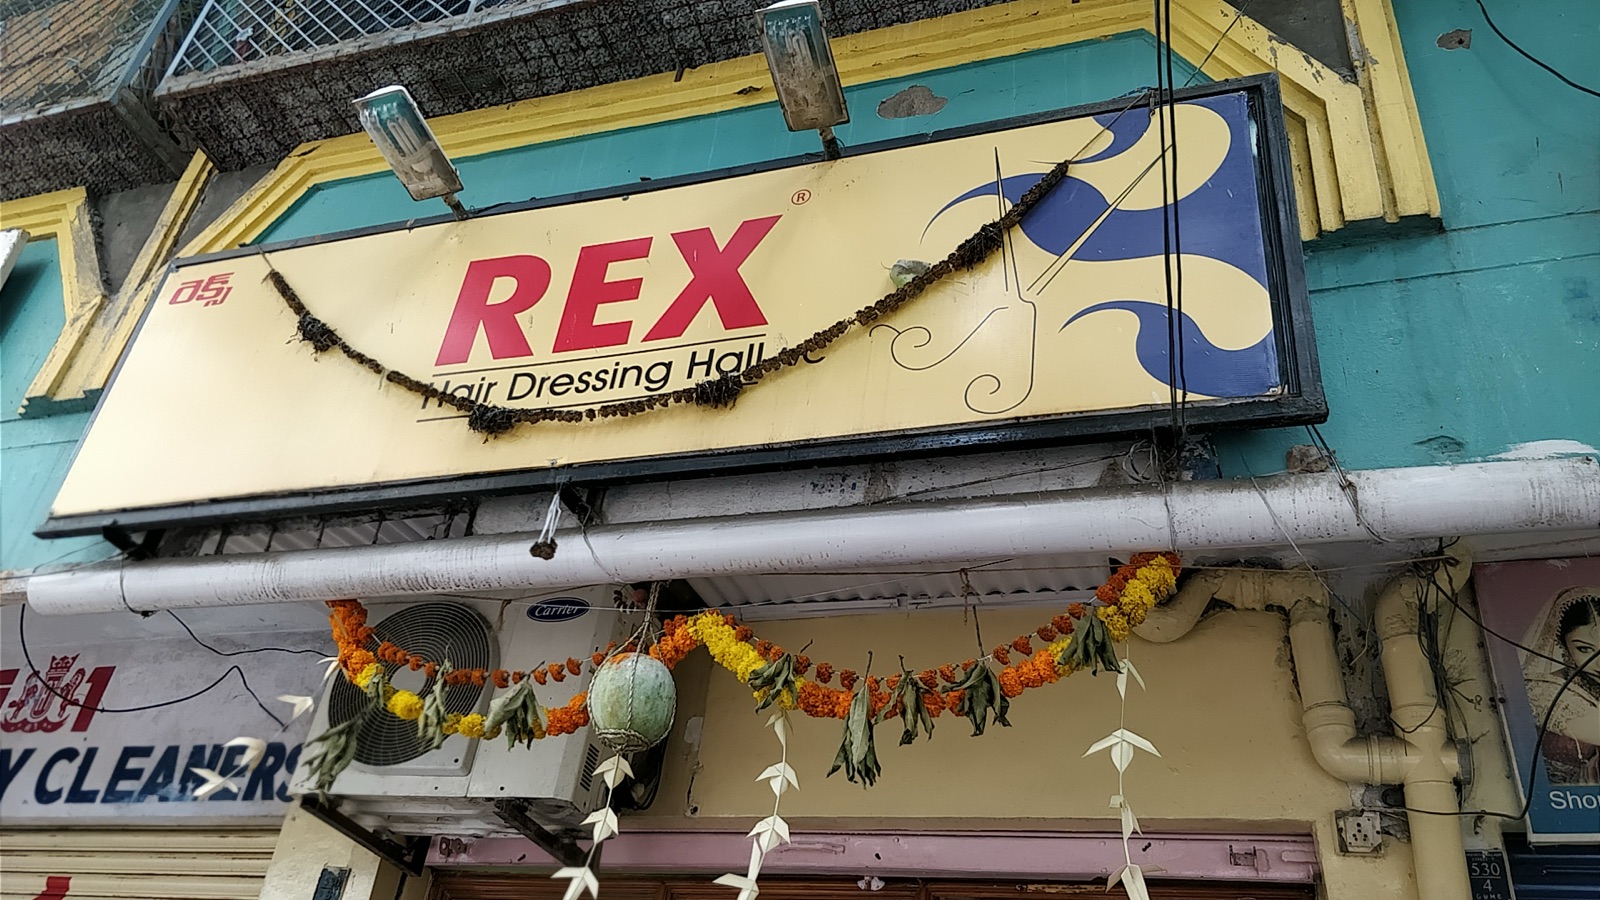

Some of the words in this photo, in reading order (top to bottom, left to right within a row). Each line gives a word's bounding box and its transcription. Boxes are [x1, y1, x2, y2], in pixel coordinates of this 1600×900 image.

[435, 214, 784, 367] REX
[506, 360, 674, 401] Dressing
[686, 342, 765, 380] Hall
[535, 604, 579, 616] Carrier
[34, 742, 306, 804] CLEANERS
[1549, 790, 1600, 810] Sho
[1471, 862, 1500, 876] 530
[1483, 879, 1492, 892] 4
